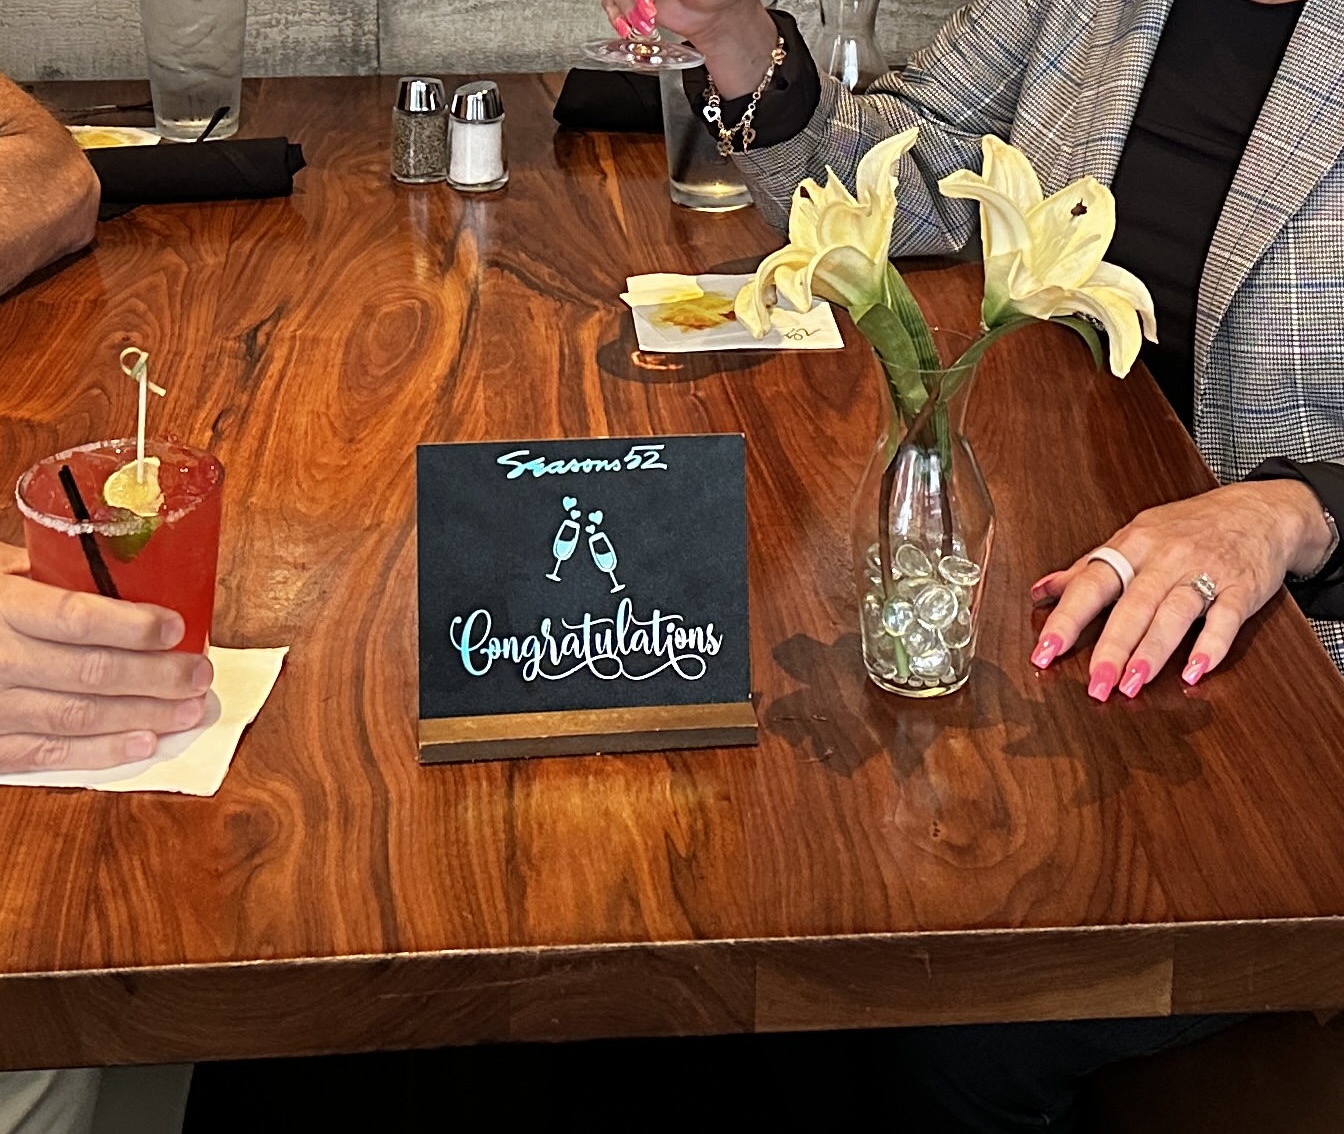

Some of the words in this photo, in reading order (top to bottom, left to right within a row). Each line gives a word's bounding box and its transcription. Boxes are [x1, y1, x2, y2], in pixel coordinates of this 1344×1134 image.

[497, 450, 622, 480] Seasons
[622, 444, 668, 471] 52
[449, 597, 724, 682] Congratulations
